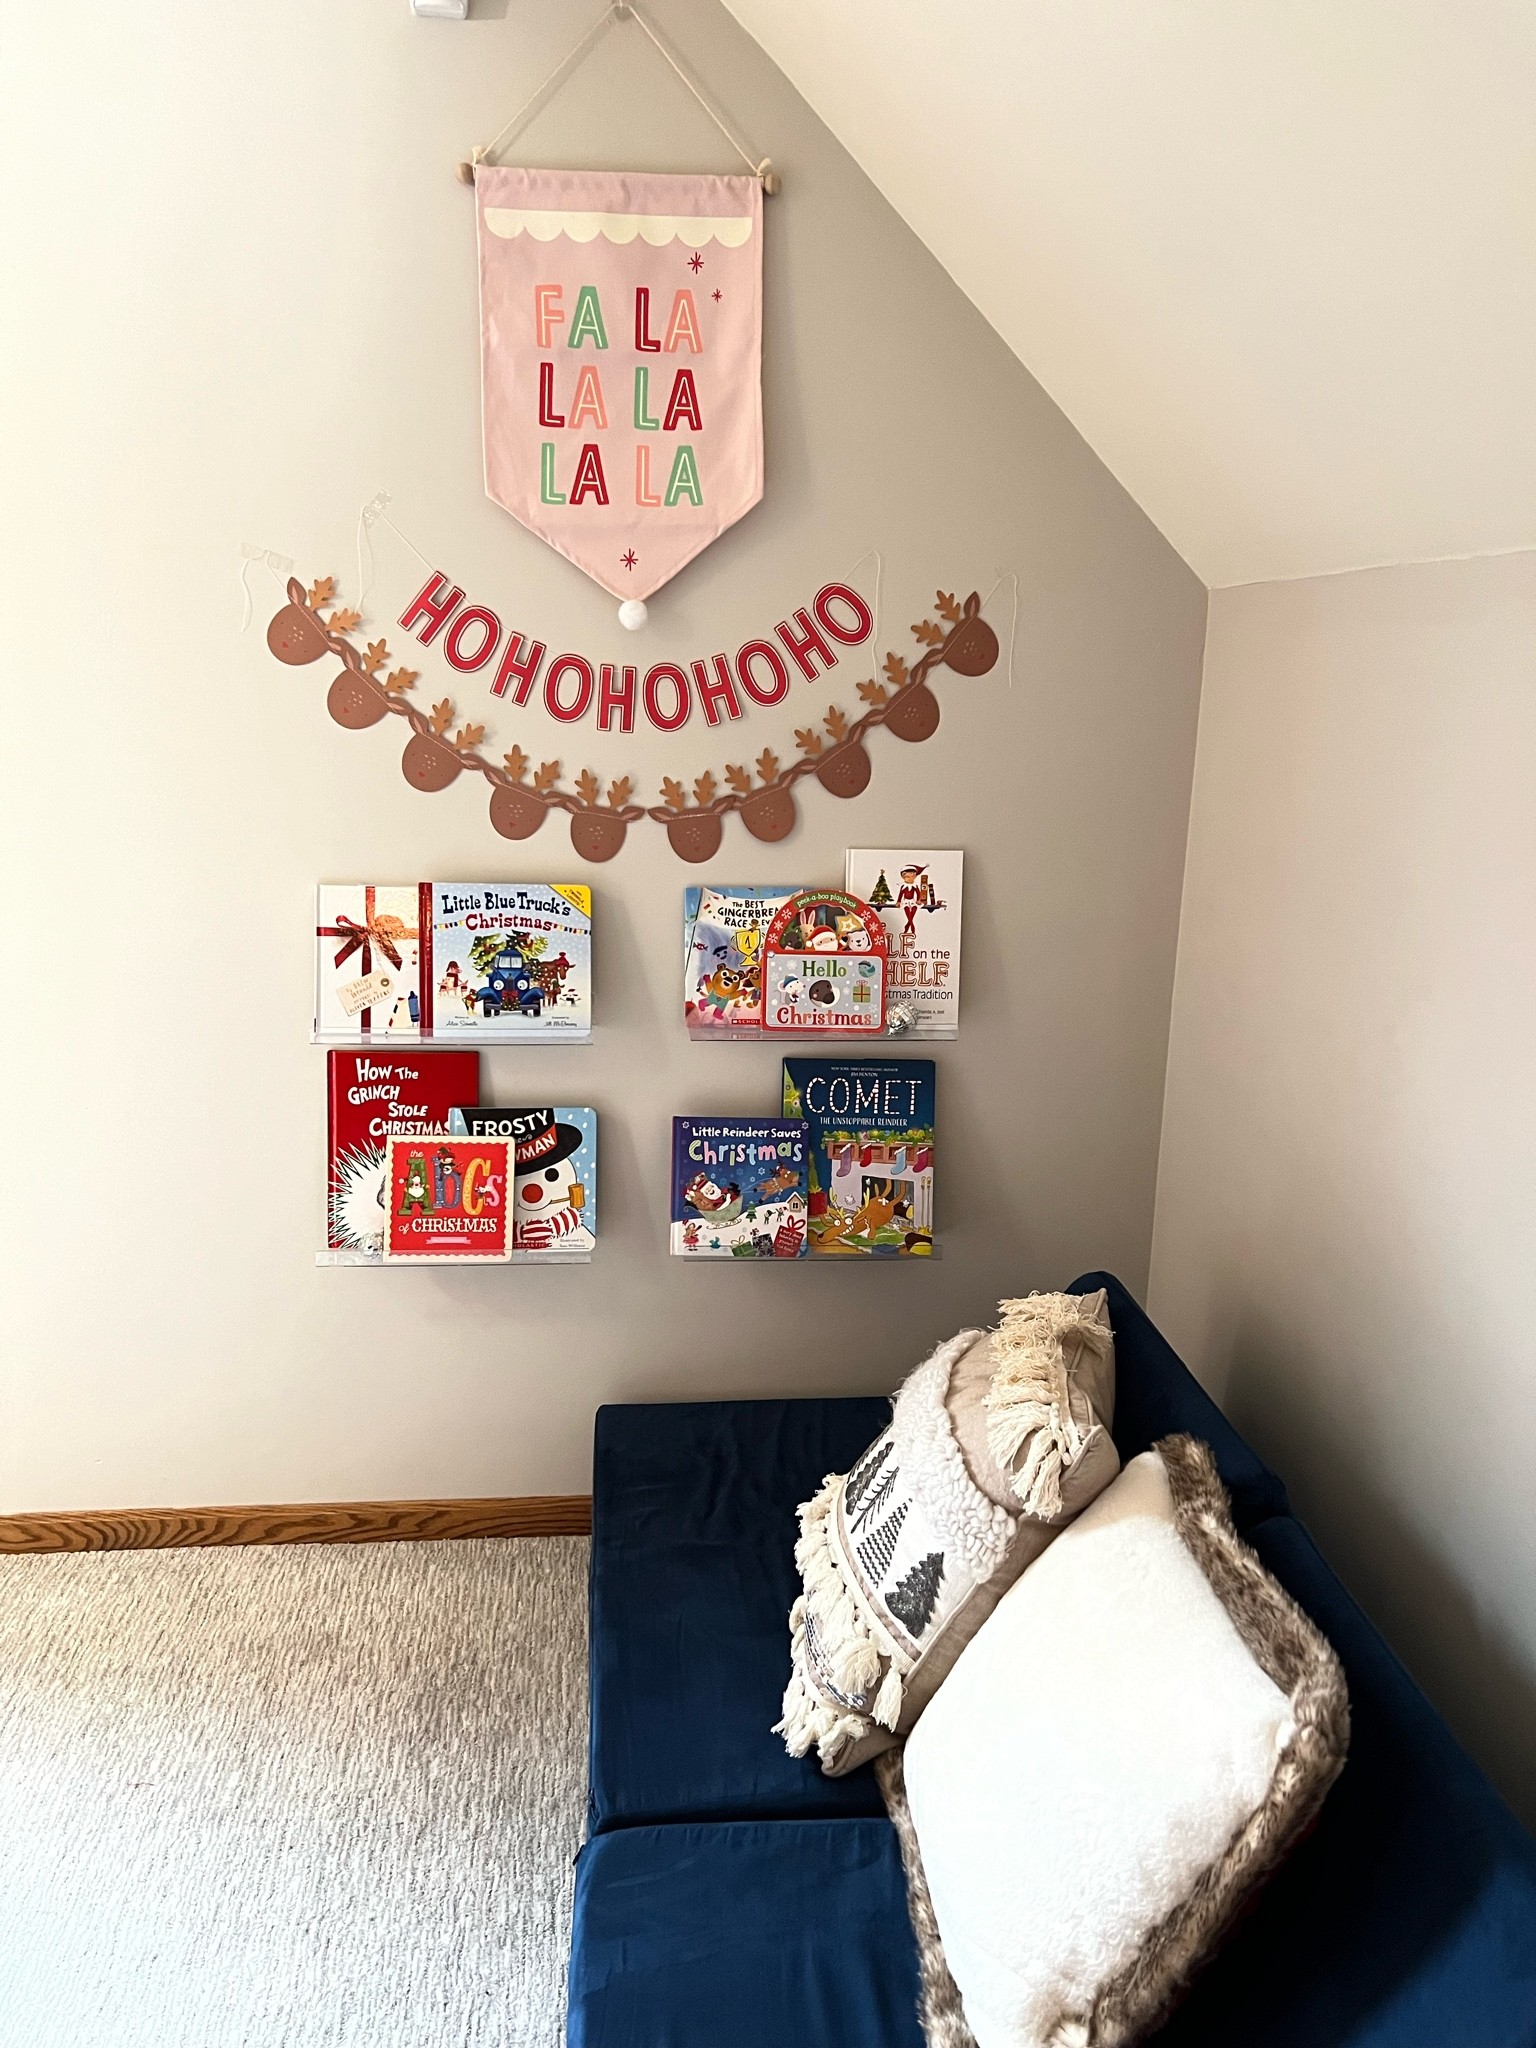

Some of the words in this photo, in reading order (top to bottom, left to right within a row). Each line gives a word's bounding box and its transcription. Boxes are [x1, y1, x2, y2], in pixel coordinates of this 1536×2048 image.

[535, 284, 608, 350] FA
[634, 287, 704, 353] LA
[538, 362, 608, 430] LA
[633, 366, 703, 431] LA
[541, 442, 610, 505] LA
[635, 444, 704, 507] LA
[441, 894, 481, 914] Little
[484, 892, 515, 909] Blue
[517, 891, 571, 916] Truck's
[744, 900, 765, 908] BEST
[796, 893, 829, 907] peek-a-boo
[717, 907, 779, 918] GINGERBRE
[465, 913, 552, 931] Christmas
[724, 918, 748, 928] RACE
[885, 933, 916, 959] LF
[913, 950, 927, 959] on
[931, 949, 950, 959] the
[802, 960, 847, 978] Hello
[885, 961, 950, 987] HELF
[912, 990, 953, 1000] Tradition
[776, 1006, 872, 1027] Christmas
[347, 1085, 400, 1105] GRINCH
[805, 1077, 922, 1115] COMET
[388, 1101, 429, 1118] STOLE
[472, 1110, 548, 1136] FROSTY
[820, 1116, 830, 1126] THE
[832, 1116, 876, 1126] UNSTOPPABLE
[878, 1117, 908, 1127] REINDEER
[692, 1127, 722, 1138] Little
[722, 1127, 769, 1138] Reindeer
[771, 1128, 802, 1138] Saves
[410, 1150, 424, 1158] the
[688, 1139, 803, 1166] Christmas
[398, 1223, 410, 1234] of
